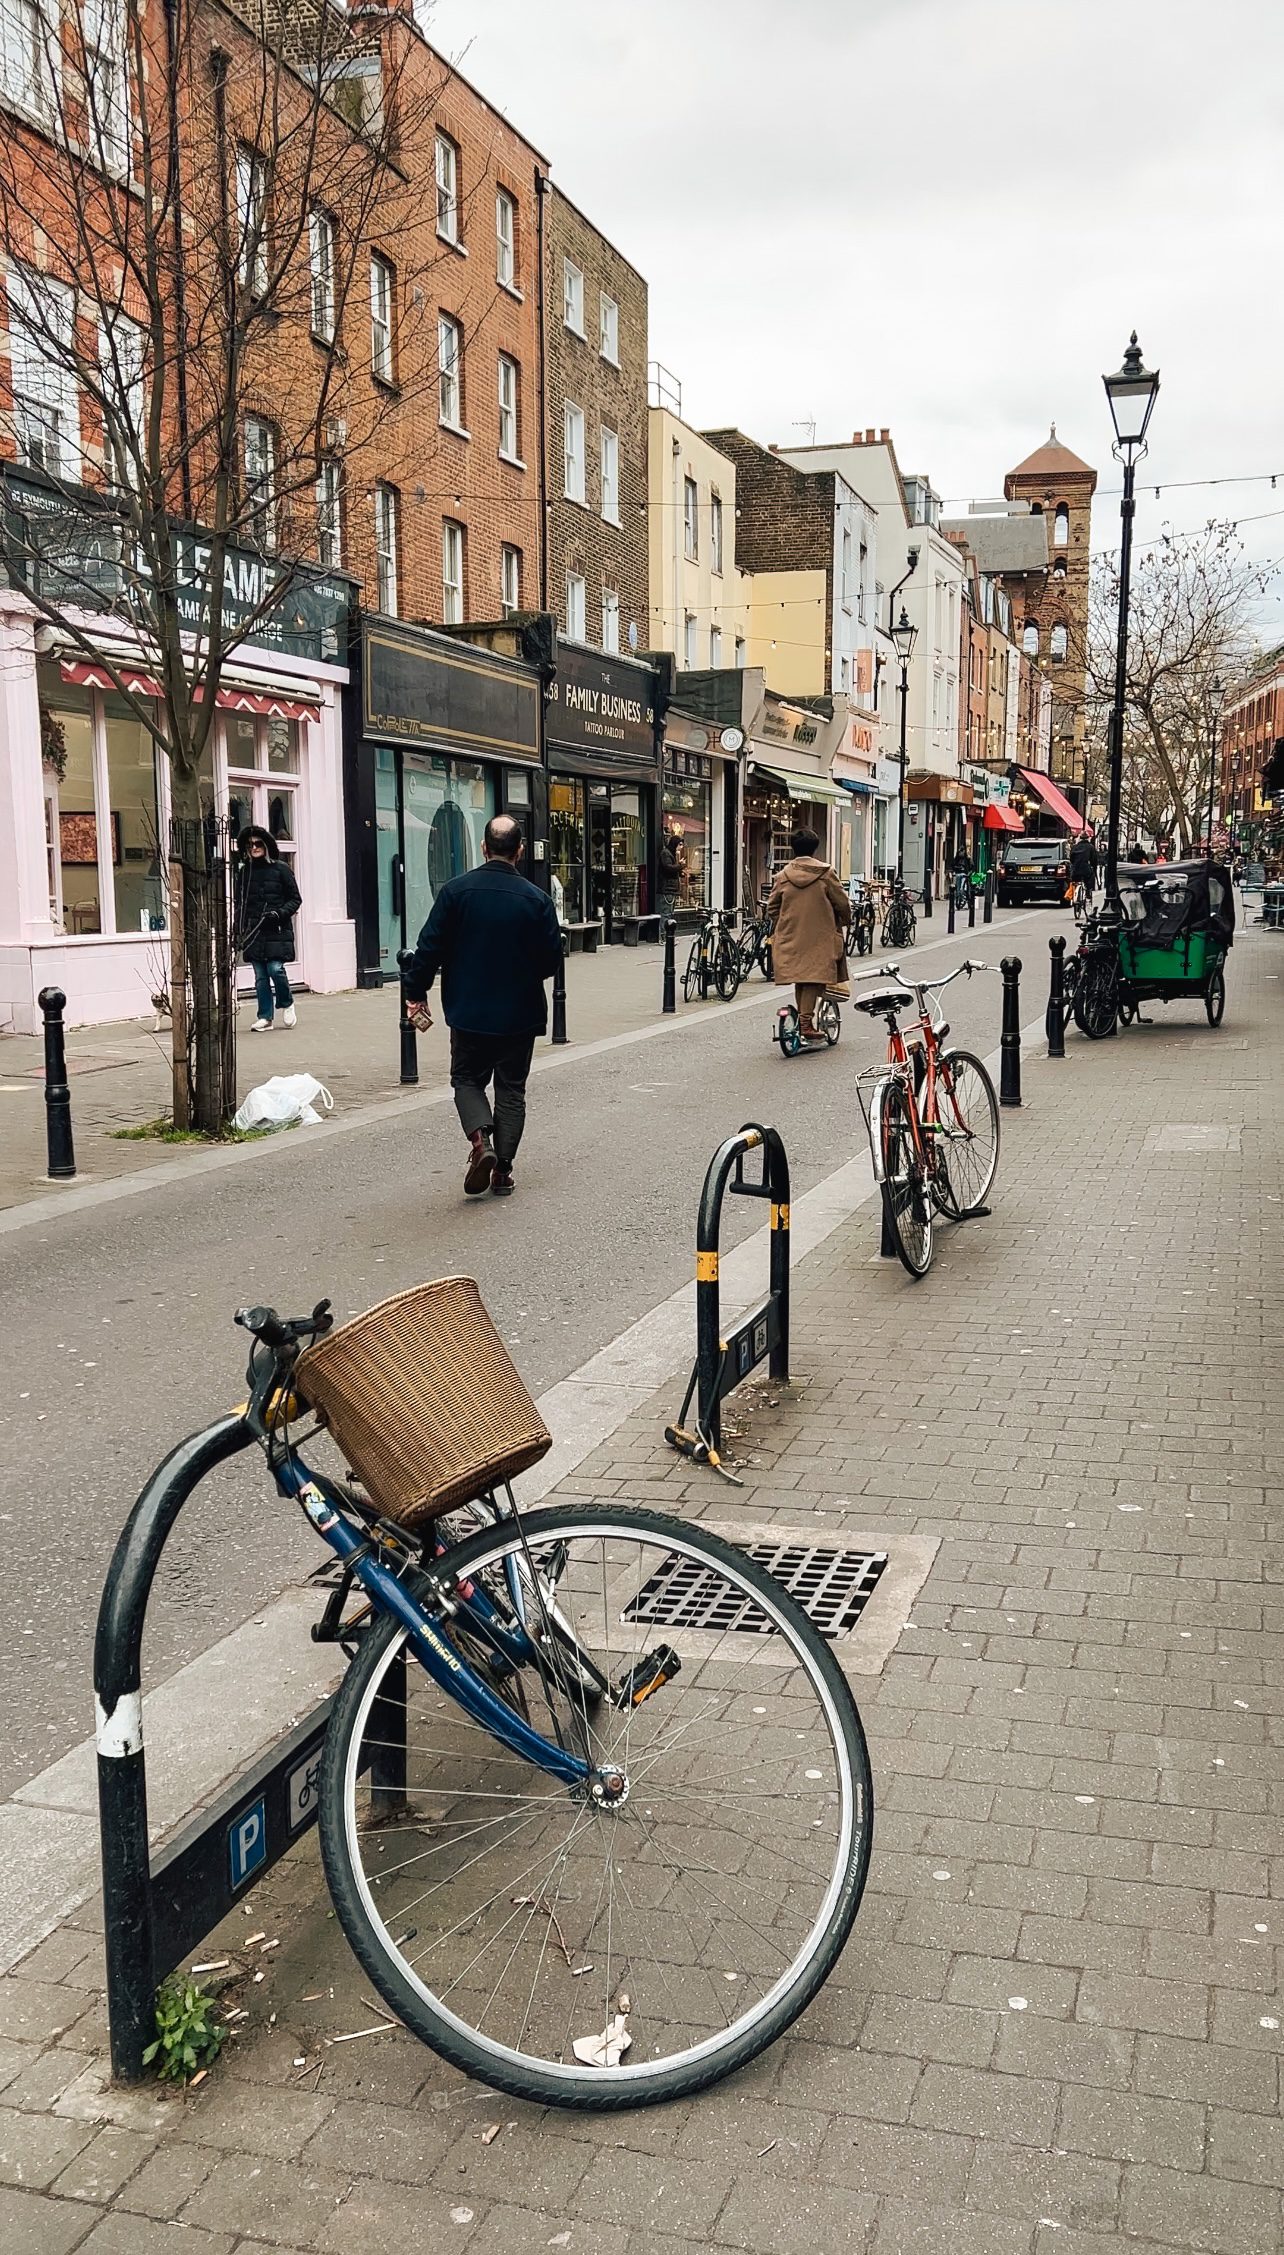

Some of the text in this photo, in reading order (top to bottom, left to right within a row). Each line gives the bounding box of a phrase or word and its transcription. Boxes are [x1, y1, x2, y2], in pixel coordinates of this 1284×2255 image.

[548, 682, 559, 701] 58
[565, 683, 642, 724] FAMILY BUSINESS
[645, 707, 655, 723] 58
[584, 721, 626, 740] TATTOO PARLOUR
[741, 1340, 748, 1369] P
[419, 1623, 461, 1672] SHIMANO
[239, 1813, 260, 1875] P
